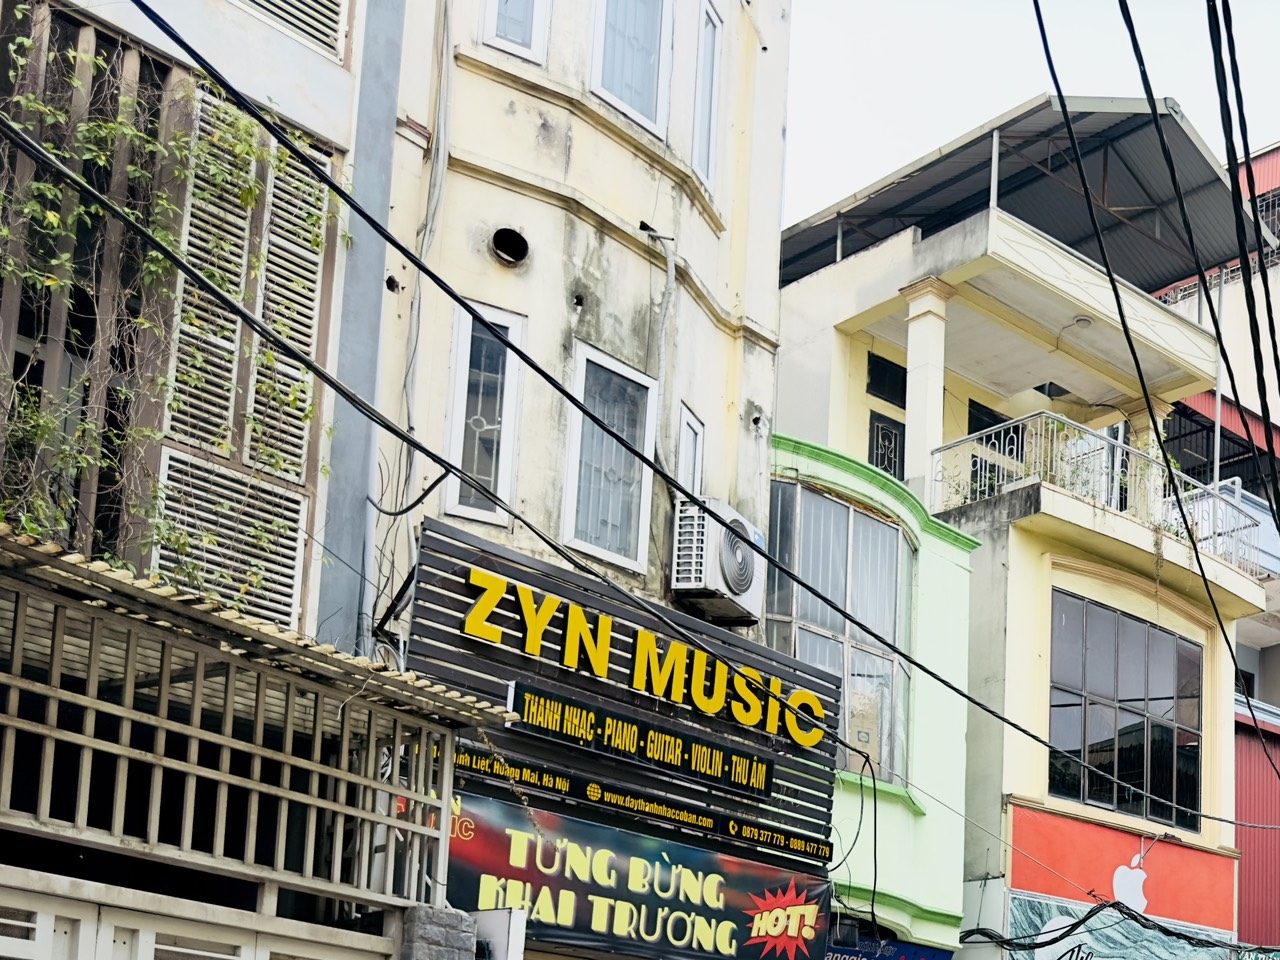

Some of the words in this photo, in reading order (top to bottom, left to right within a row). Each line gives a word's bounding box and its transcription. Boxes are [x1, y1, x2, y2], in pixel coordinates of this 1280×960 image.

[464, 567, 613, 678] ZYN
[632, 629, 825, 748] MUSIC
[523, 692, 561, 732] THANH
[563, 705, 595, 746] NHẠC
[604, 717, 638, 754] PIANO
[646, 729, 682, 767] GUITAR
[691, 742, 723, 779] VIOLIN
[731, 754, 749, 786] THU
[749, 756, 766, 791] ÂM
[471, 755, 491, 774] Liệt,
[521, 767, 541, 786] Mai,
[542, 772, 554, 788] Hà
[555, 778, 570, 793] Nội
[742, 825, 759, 840] 0879
[759, 830, 772, 843] 377
[773, 833, 785, 846] 779
[806, 842, 818, 855] 477
[818, 845, 830, 858] 779
[477, 873, 576, 927] KHAI
[751, 904, 819, 940] HOT!
[628, 852, 725, 911] BỪNG
